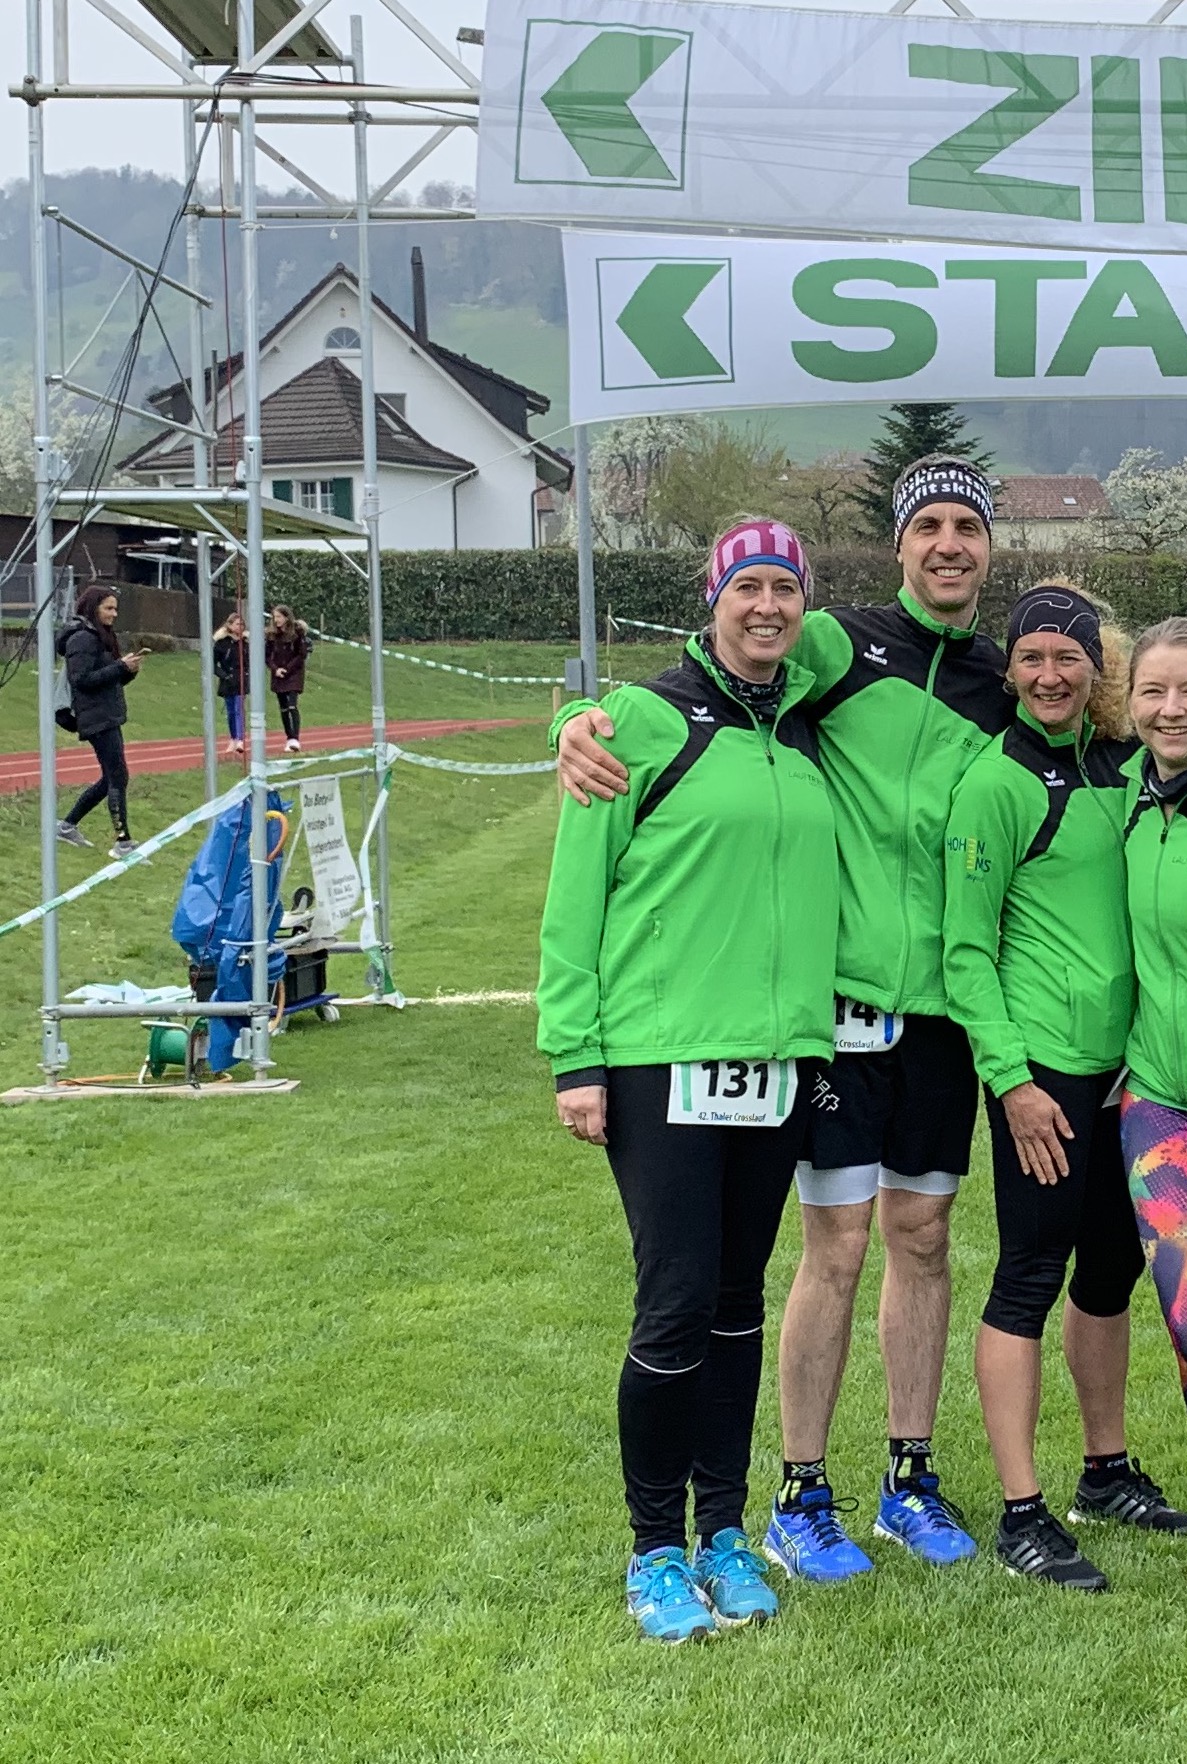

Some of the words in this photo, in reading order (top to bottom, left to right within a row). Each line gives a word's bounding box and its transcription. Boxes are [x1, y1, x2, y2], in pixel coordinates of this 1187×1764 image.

[701, 1060, 769, 1100] 131
[697, 1111, 709, 1121] 42.
[733, 1112, 767, 1123] Crosslauf
